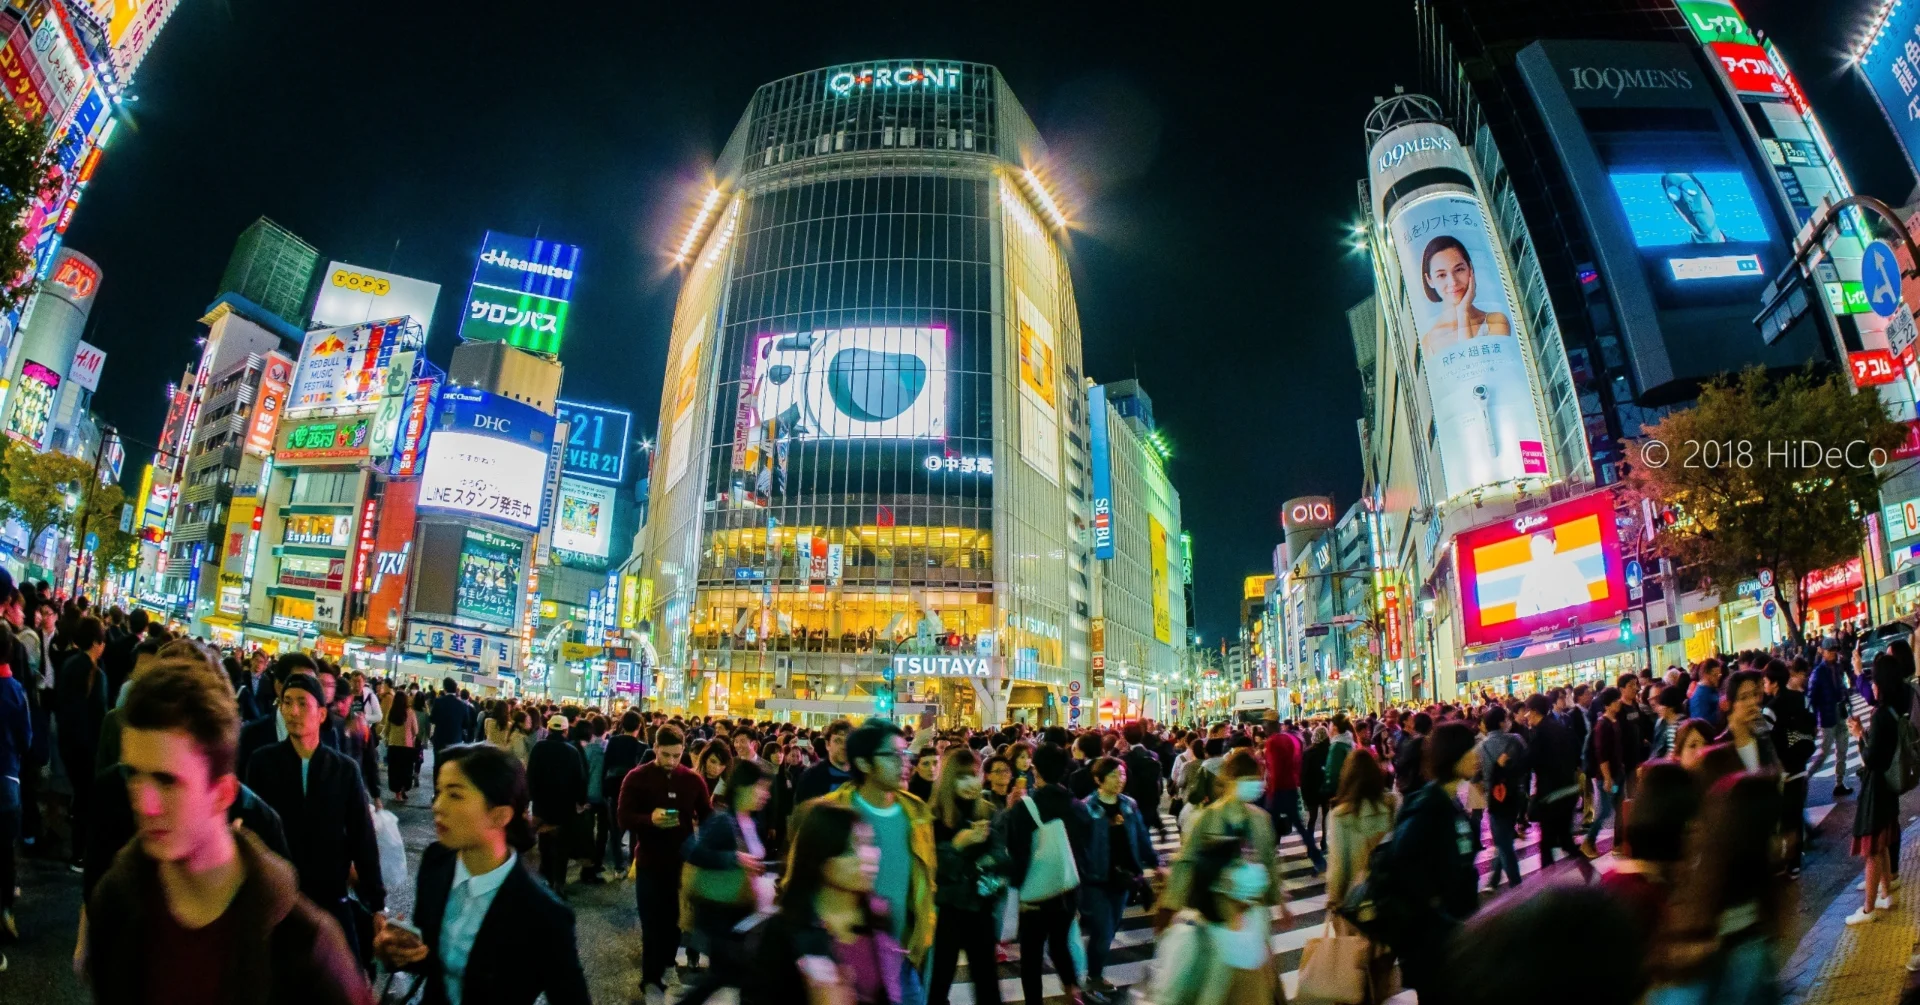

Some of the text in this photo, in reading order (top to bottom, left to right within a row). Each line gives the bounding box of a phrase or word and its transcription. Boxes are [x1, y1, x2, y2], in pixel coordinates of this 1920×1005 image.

[1692, 13, 1742, 34] レイク
[1721, 57, 1774, 75] アイフル
[480, 249, 573, 280] Hisamitsu
[54, 264, 93, 298] 109
[337, 275, 387, 291] TOPY
[471, 300, 557, 334] サロンパス
[76, 347, 101, 374] H&M
[310, 357, 339, 369] RED BULL
[1855, 357, 1891, 378] アコム
[310, 369, 333, 379] MUSIC
[304, 382, 334, 391] FESTIVAL
[457, 394, 482, 402] Channel
[400, 383, 432, 468] 三千里薬品
[473, 414, 511, 433] DHC
[1522, 450, 1544, 458] Panasonic
[1523, 458, 1541, 466] Beauty
[601, 456, 619, 473] 21
[427, 487, 532, 518] LINE スタンプ発売中
[541, 488, 554, 528] neon
[1095, 497, 1110, 548] SEIBU
[287, 531, 331, 545] Euphoria
[1025, 616, 1062, 640] TSUTAYA
[894, 656, 990, 675] TSUTAYA
